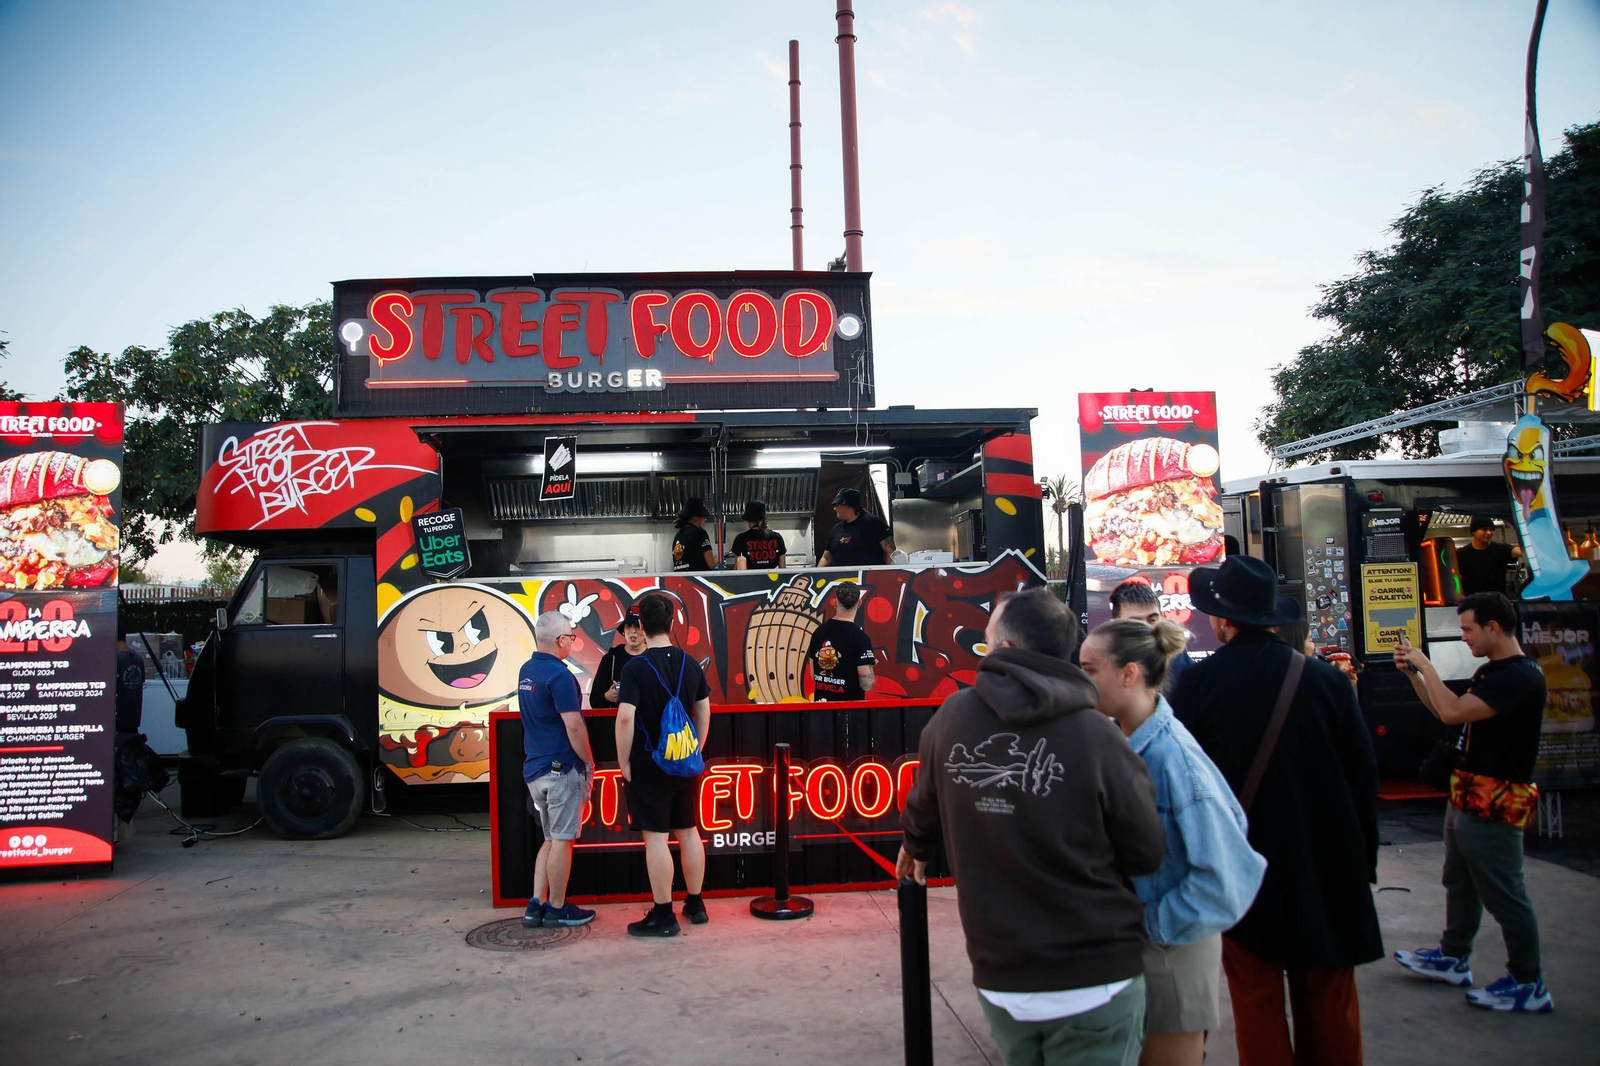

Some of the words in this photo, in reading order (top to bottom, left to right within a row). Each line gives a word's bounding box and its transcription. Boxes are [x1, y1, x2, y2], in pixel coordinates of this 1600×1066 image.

[367, 292, 618, 368] STREET
[630, 292, 834, 364] FOOD
[548, 369, 662, 389] BURGER
[1103, 405, 1151, 420] STREET
[1152, 405, 1194, 419] FOOD
[48, 417, 95, 432] FOOD
[214, 421, 339, 494] STREET
[231, 449, 328, 498] FOOD
[549, 474, 569, 482] PÍDELA
[249, 446, 439, 530] BURGER
[545, 480, 572, 494] AQUÍ
[418, 513, 456, 527] RECOGE
[432, 524, 454, 532] PEDIDO
[419, 534, 461, 551] Uber
[746, 540, 778, 551] STREET
[422, 549, 465, 568] Eats
[750, 549, 777, 560] FOOD
[28, 608, 42, 619] LA
[1522, 621, 1542, 632] LA
[1376, 636, 1410, 644] VEGA
[1523, 629, 1590, 645] MEJOR
[12, 669, 35, 677] GIJÓN
[36, 682, 88, 691] CAMPEONES
[89, 681, 106, 689] TCB
[38, 690, 84, 698] SANTANDER
[7, 713, 38, 721] SEVILLA
[0, 726, 54, 735] MBURGUESA
[55, 725, 67, 733] DE
[69, 724, 104, 733] SEVILLA
[6, 734, 52, 742] CHAMPIONS
[54, 733, 85, 741] BURGER
[1, 757, 27, 765] brioche
[28, 757, 42, 765] rojo
[9, 781, 51, 789] temperatura
[52, 779, 78, 787] durante
[28, 788, 51, 796] blanco
[53, 787, 84, 795] ahumado
[47, 795, 66, 803] estilo
[67, 794, 87, 802] street
[9, 805, 22, 813] bits
[24, 803, 72, 812] caramelizados
[27, 812, 36, 820] de
[713, 832, 776, 848] BURGE
